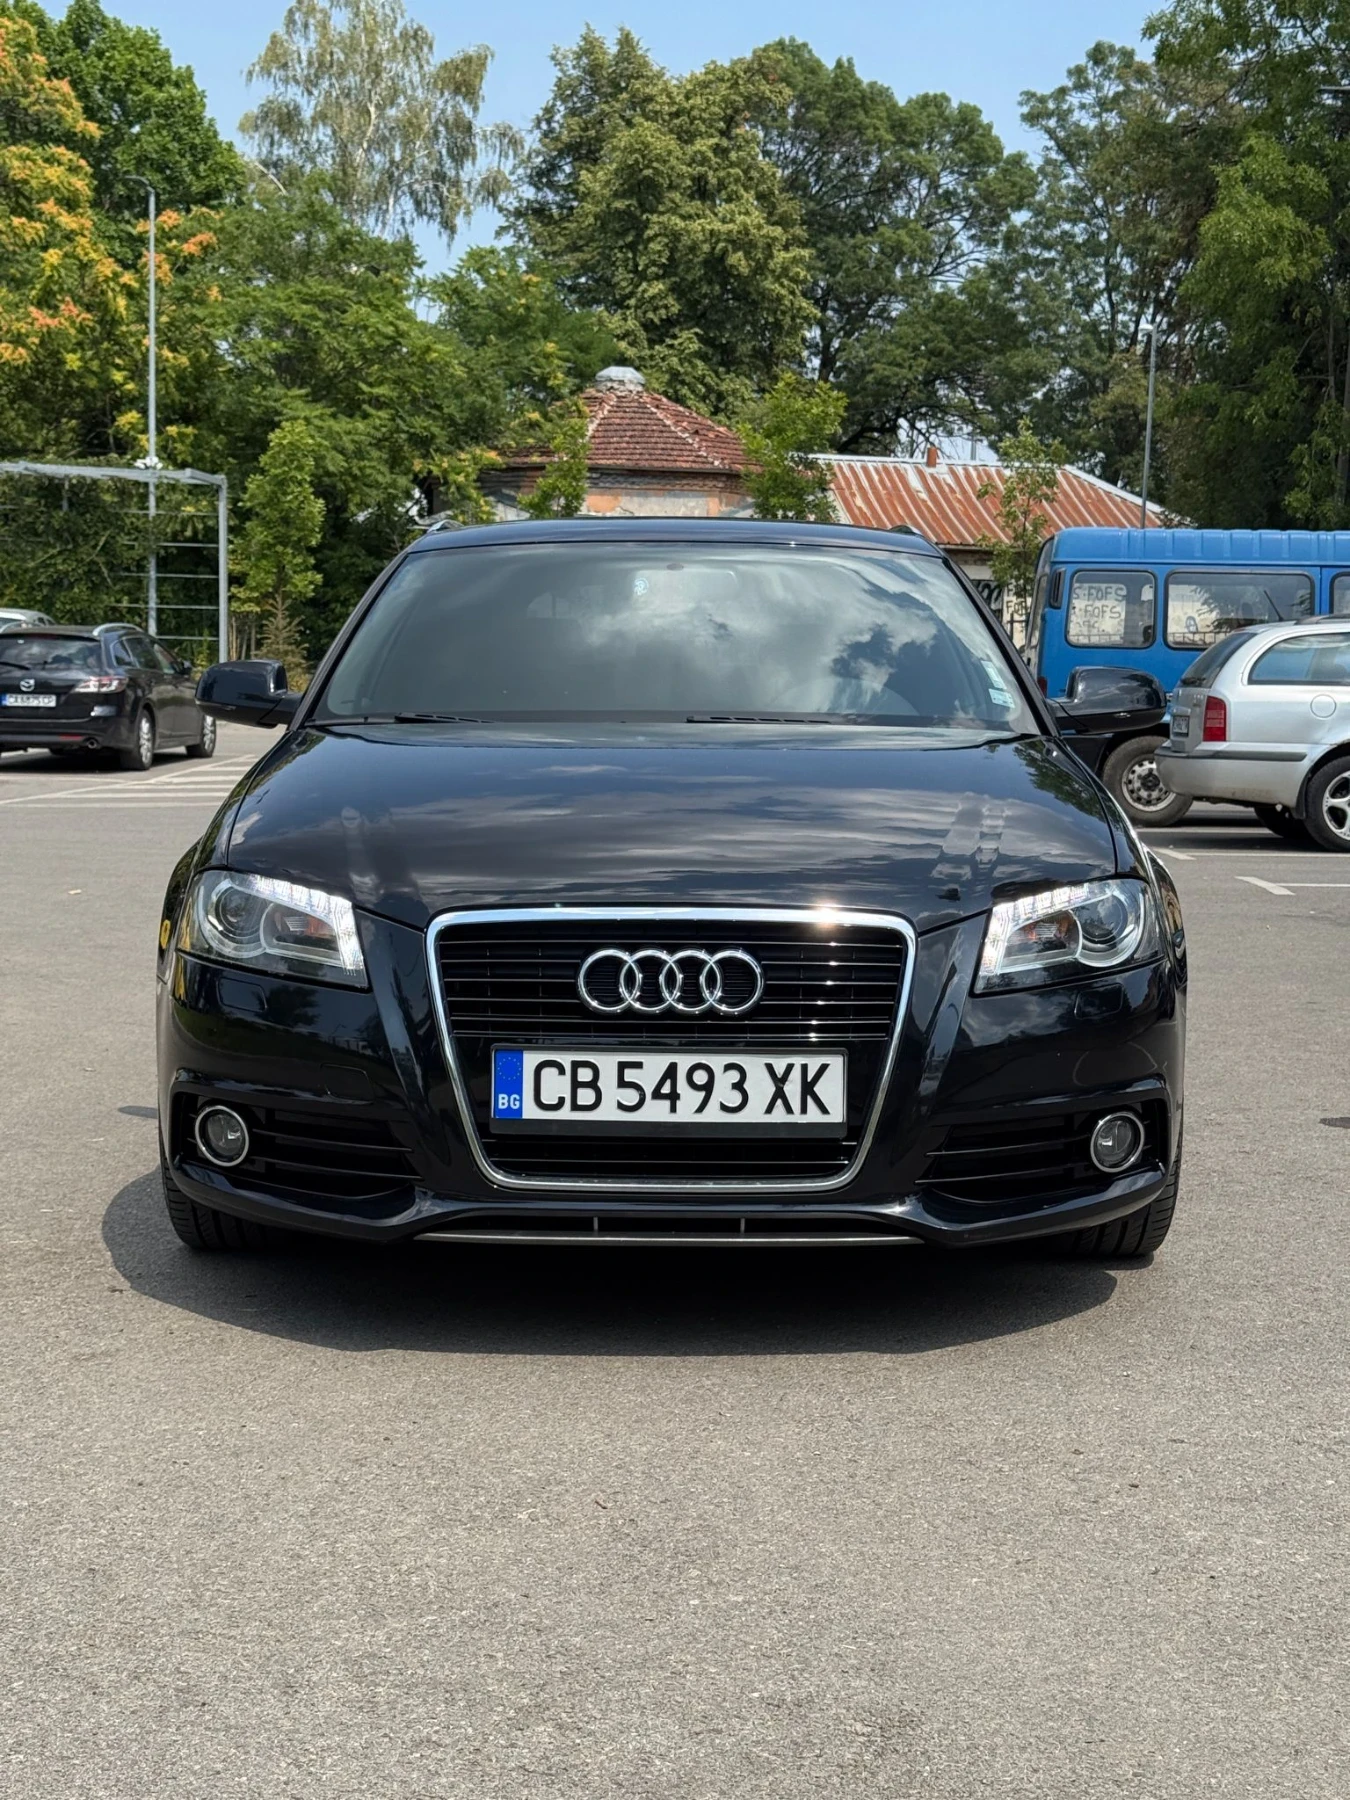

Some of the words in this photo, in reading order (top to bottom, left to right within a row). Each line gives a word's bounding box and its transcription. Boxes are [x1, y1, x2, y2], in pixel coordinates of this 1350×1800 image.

[498, 1094, 520, 1109] BG
[534, 1059, 602, 1112] CB
[617, 1061, 749, 1114] 5493
[764, 1062, 831, 1115] XK
